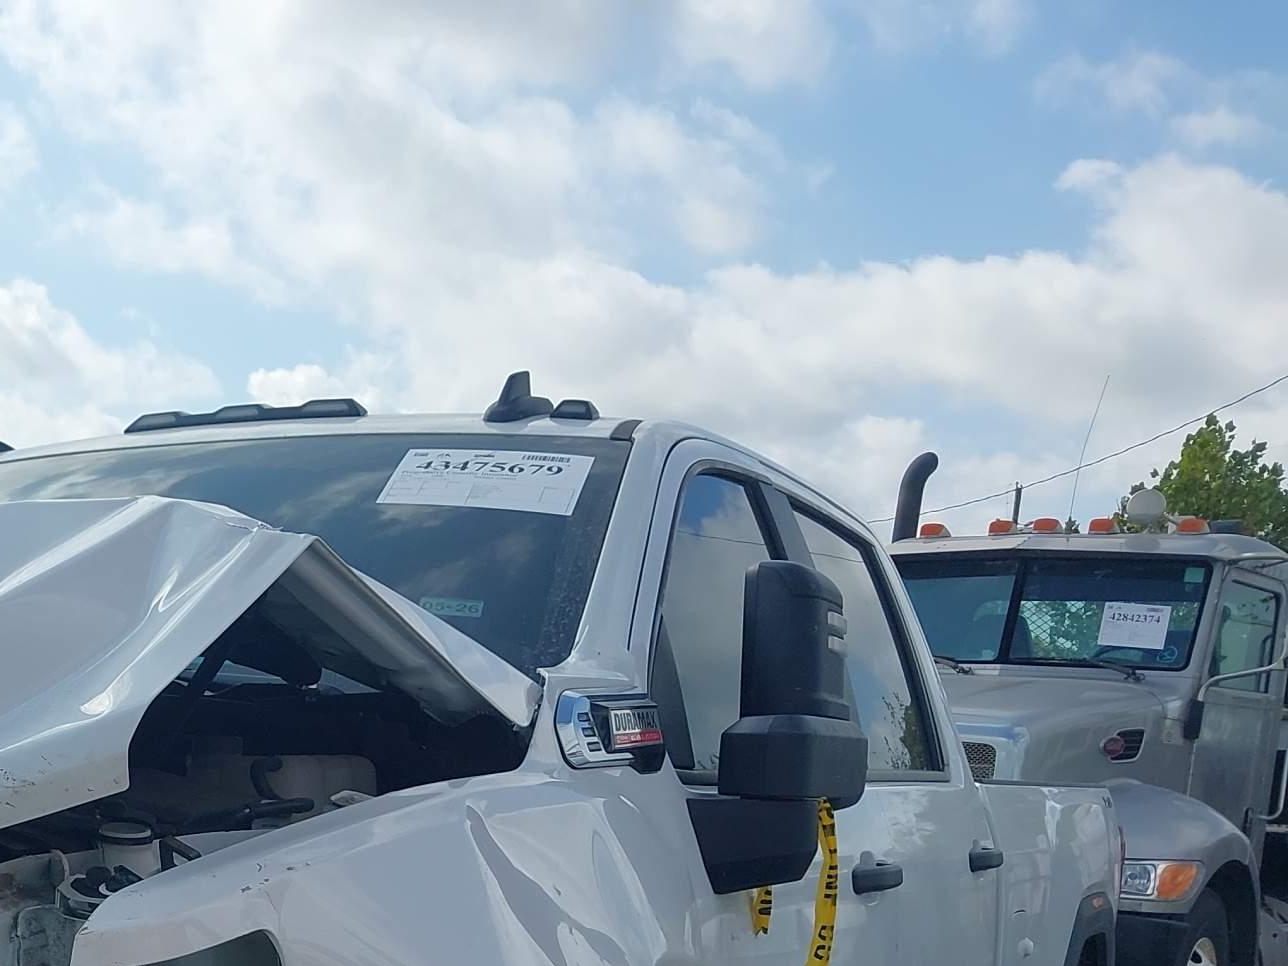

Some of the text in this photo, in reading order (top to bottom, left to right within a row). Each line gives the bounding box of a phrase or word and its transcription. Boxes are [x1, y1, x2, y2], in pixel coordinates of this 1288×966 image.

[415, 459, 564, 477] 43475679
[1109, 611, 1161, 624] 42842374
[614, 711, 657, 731] DURAMAX
